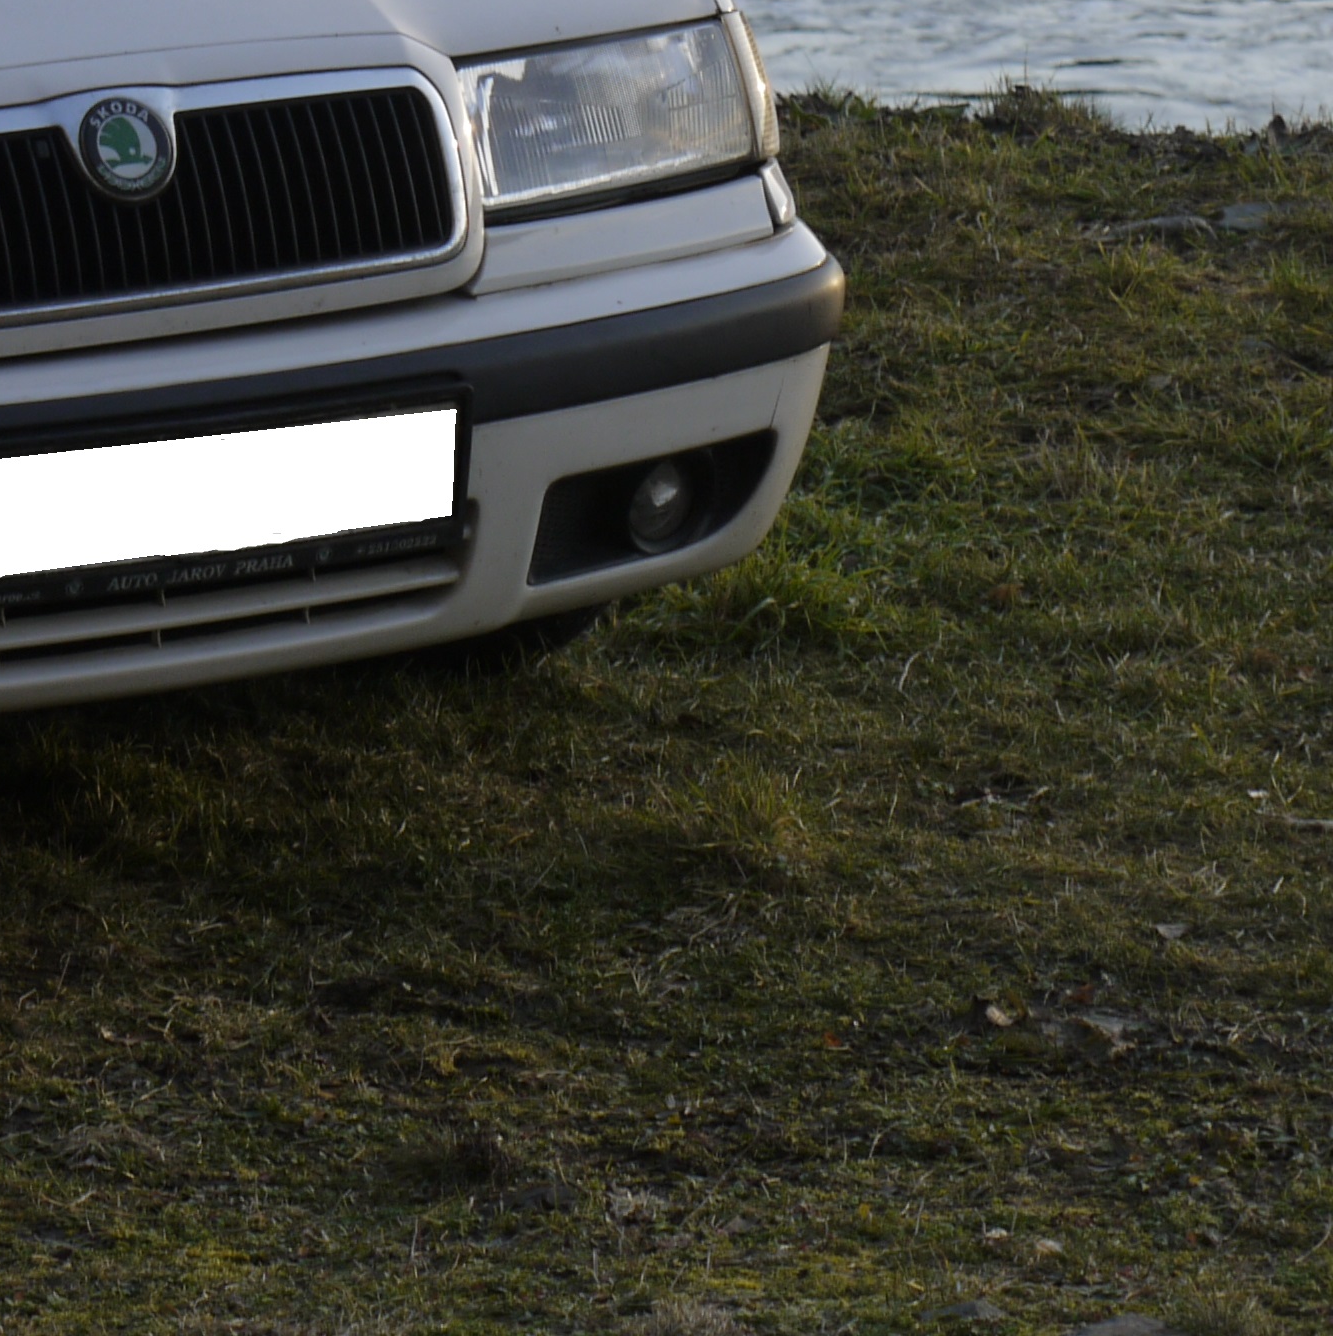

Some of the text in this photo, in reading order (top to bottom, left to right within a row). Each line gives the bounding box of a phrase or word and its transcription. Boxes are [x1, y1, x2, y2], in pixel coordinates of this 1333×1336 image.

[106, 554, 294, 592] AUTO JAROV PRAHA
